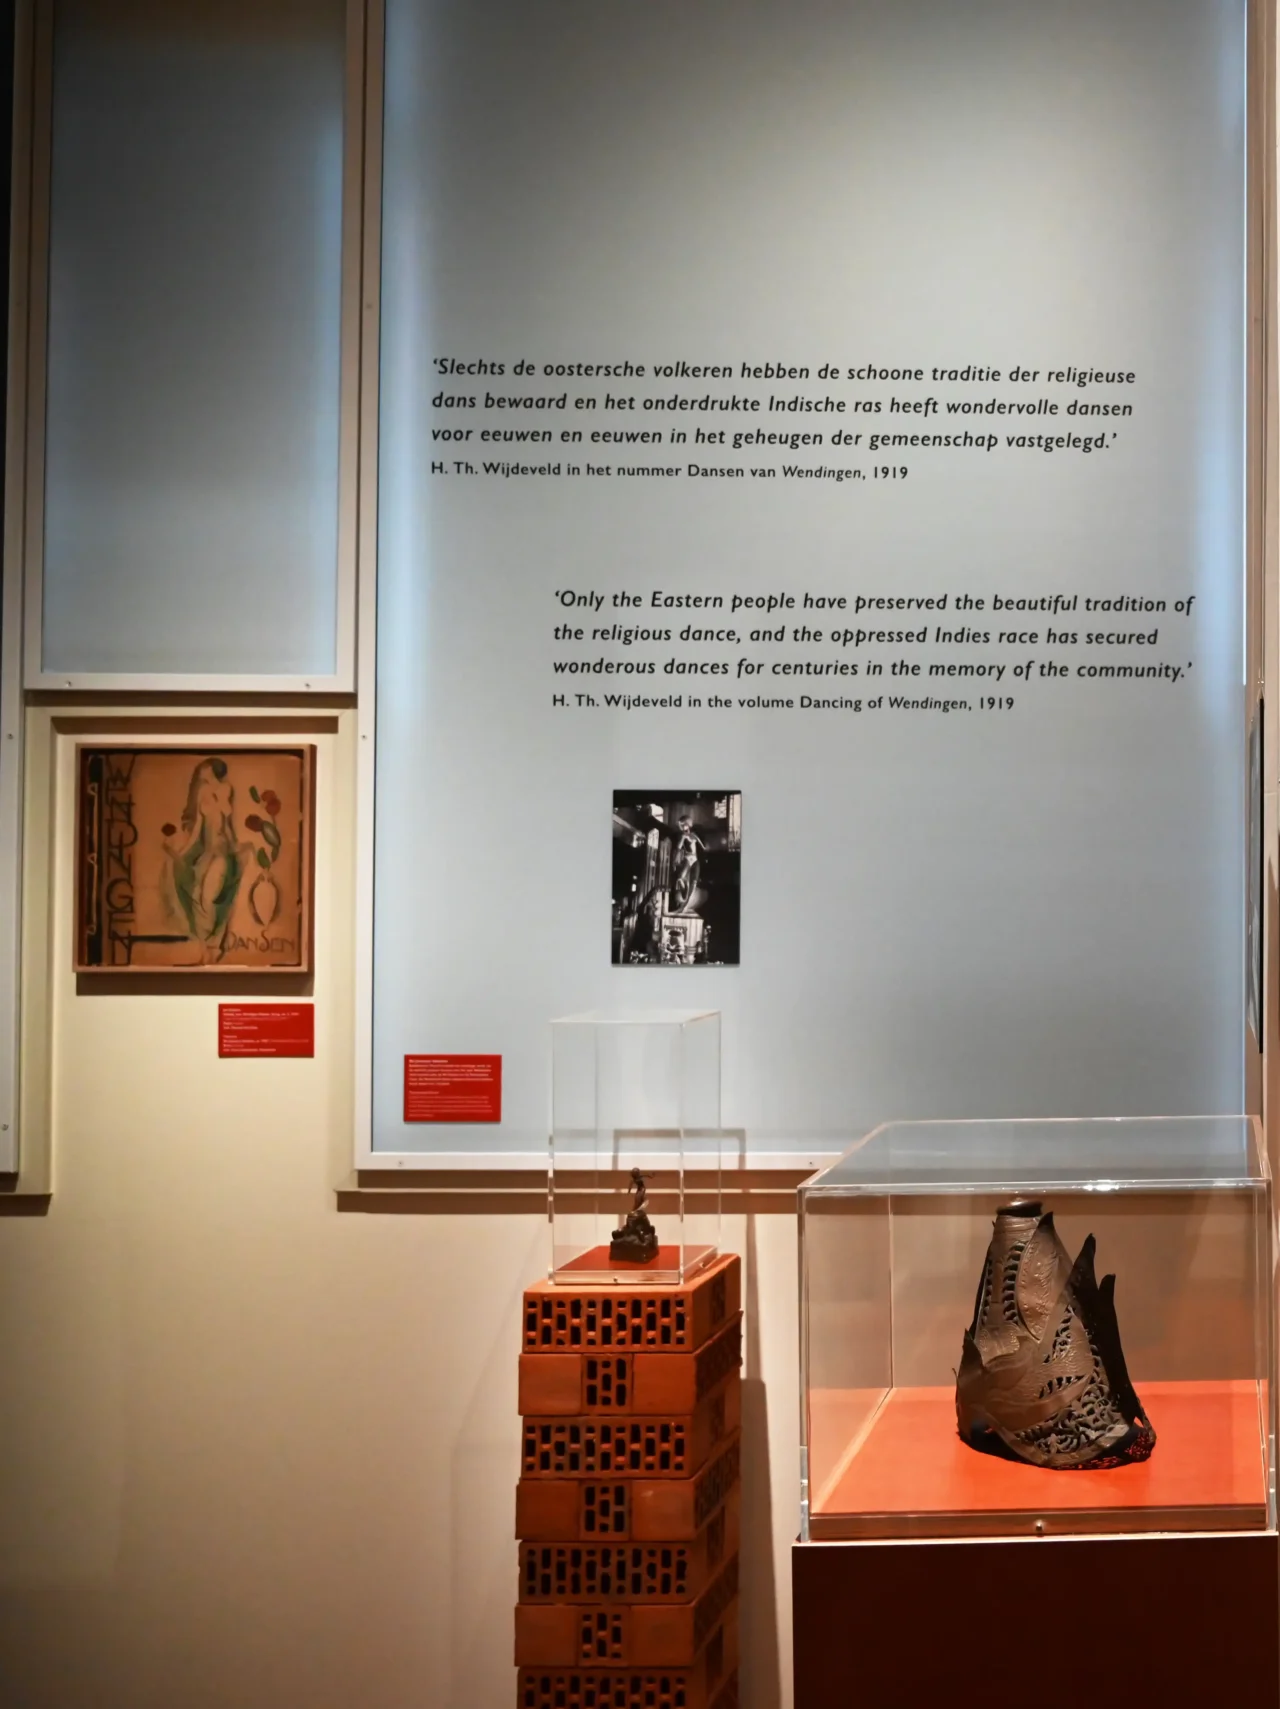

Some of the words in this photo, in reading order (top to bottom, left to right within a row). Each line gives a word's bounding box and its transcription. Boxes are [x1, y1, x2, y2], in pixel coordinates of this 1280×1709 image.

[512, 359, 536, 376] de
[543, 360, 646, 378] oostersche
[653, 360, 733, 379] volkeren
[740, 361, 810, 380] hebben
[817, 362, 840, 380] de
[846, 363, 924, 381] schoone
[931, 364, 1002, 382] traditie
[1008, 365, 1041, 383] der
[1047, 366, 1136, 388] religieuse
[431, 391, 477, 409] dans
[484, 391, 568, 410] bewaard
[574, 397, 597, 410] en
[604, 393, 636, 411] het
[642, 393, 761, 412] onderdrukte
[768, 395, 847, 413] Indische
[853, 401, 883, 414] ras
[889, 396, 939, 418] heeft
[946, 397, 1059, 416] wondervolle
[1066, 399, 1133, 417] dansen
[431, 429, 474, 442] voor
[480, 429, 553, 443] eeuwen
[560, 430, 583, 443] en
[590, 431, 663, 444] eeuwen
[670, 427, 687, 444] in
[694, 427, 726, 445] het
[731, 427, 823, 450] geheugen
[830, 428, 863, 446] der
[868, 430, 999, 453] gemeenschap
[431, 460, 449, 475] H.
[452, 461, 479, 475] Th.
[482, 461, 561, 479] Wijdeveld
[566, 463, 581, 476] in
[586, 462, 612, 477] het
[616, 466, 683, 477] nummer
[687, 463, 745, 478] Dansen
[749, 468, 776, 478] van
[781, 464, 866, 483] Wendingen,
[873, 465, 909, 480] 1919
[612, 590, 643, 608] the
[650, 590, 724, 609] Eastern
[730, 591, 796, 614] people
[803, 592, 847, 610] have
[854, 593, 948, 615] preserved
[954, 593, 985, 611] the
[992, 593, 1078, 616] beautiful
[1084, 595, 1167, 613] tradition
[1174, 595, 1197, 617] of
[553, 623, 585, 641] the
[591, 623, 672, 646] religious
[679, 624, 742, 645] dance,
[749, 624, 786, 643] and
[792, 625, 823, 643] the
[830, 626, 928, 648] oppressed
[935, 626, 991, 644] Indies
[998, 631, 1039, 645] race
[1046, 627, 1079, 645] has
[1085, 628, 1159, 646] secured
[553, 656, 656, 675] wonderous
[663, 657, 730, 675] dances
[736, 657, 765, 680] for
[771, 659, 859, 676] centuries
[866, 659, 883, 676] in
[890, 659, 922, 677] the
[928, 664, 1007, 682] memory
[1012, 659, 1036, 682] of
[1039, 660, 1070, 678] the
[552, 693, 570, 707] H.
[574, 693, 600, 708] Th.
[603, 694, 683, 711] Wijdeveld
[687, 695, 702, 708] in
[707, 694, 733, 709] the
[737, 695, 794, 709] volume
[799, 695, 863, 713] Dancing
[867, 695, 884, 710] of
[888, 696, 972, 714] Wendingen,
[980, 696, 1015, 710] 1919
